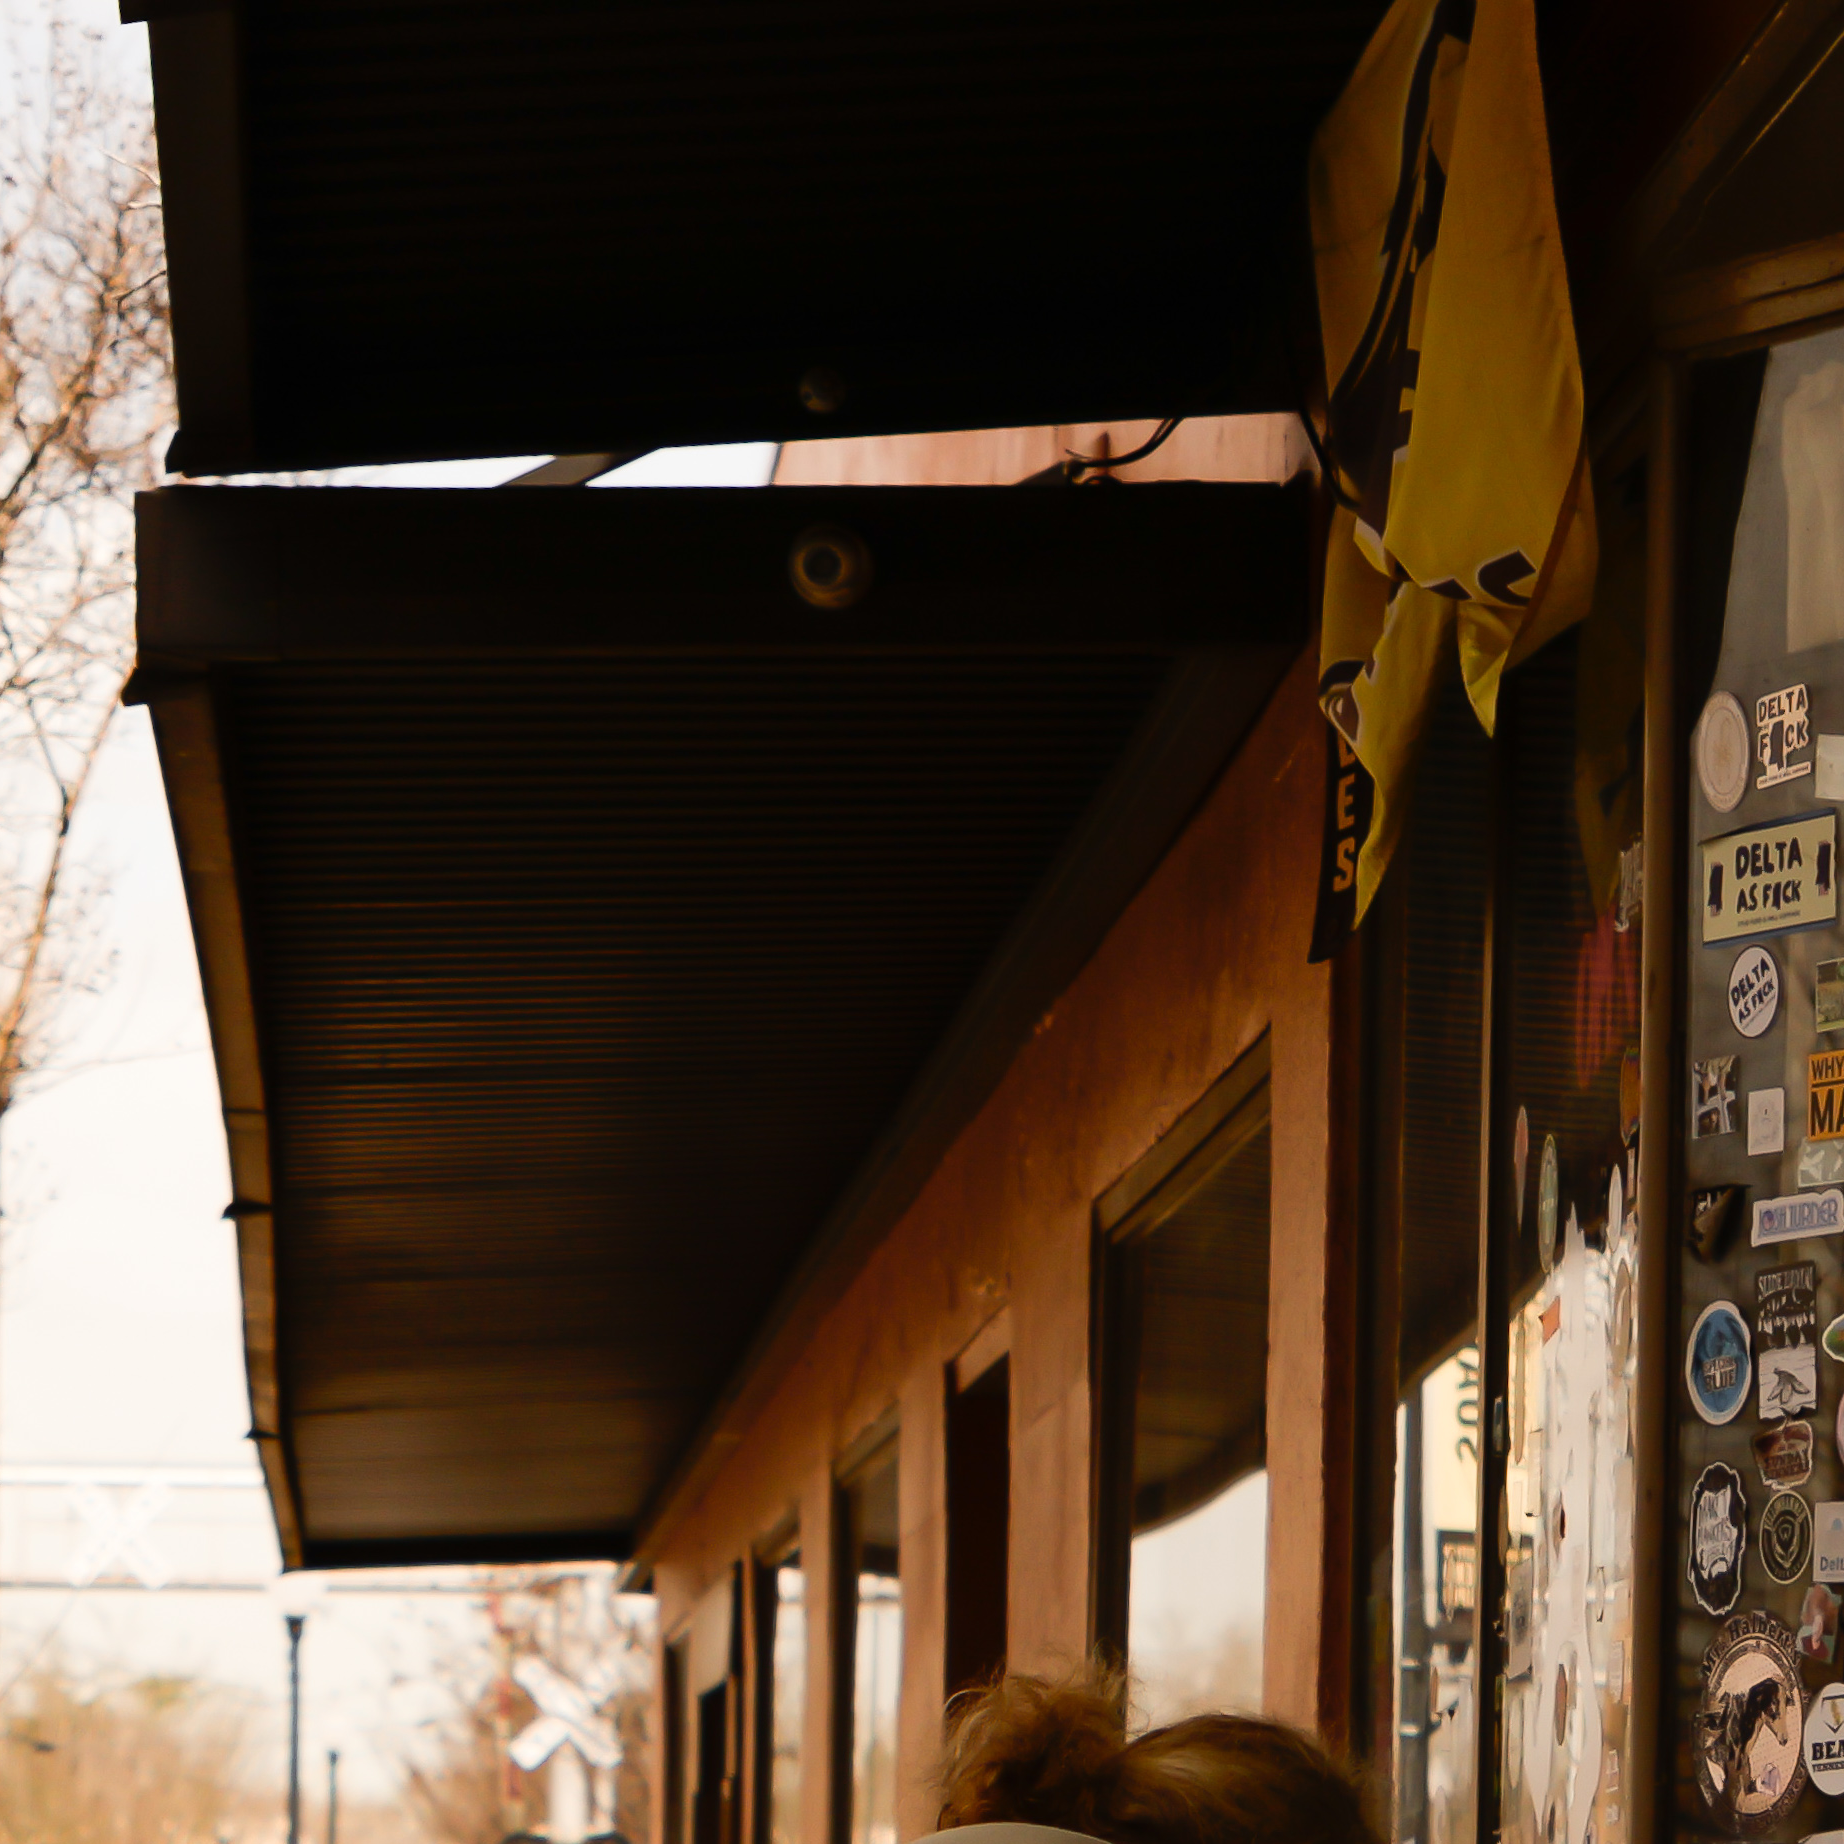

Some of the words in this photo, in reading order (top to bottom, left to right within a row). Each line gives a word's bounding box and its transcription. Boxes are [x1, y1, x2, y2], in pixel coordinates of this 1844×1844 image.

[1758, 688, 1805, 723] DELTA
[1735, 837, 1802, 880] DELTA
[1736, 883, 1758, 914] AS
[1731, 957, 1770, 1007] DELTA
[1739, 1005, 1750, 1023] AS
[1812, 1055, 1844, 1080] WHY
